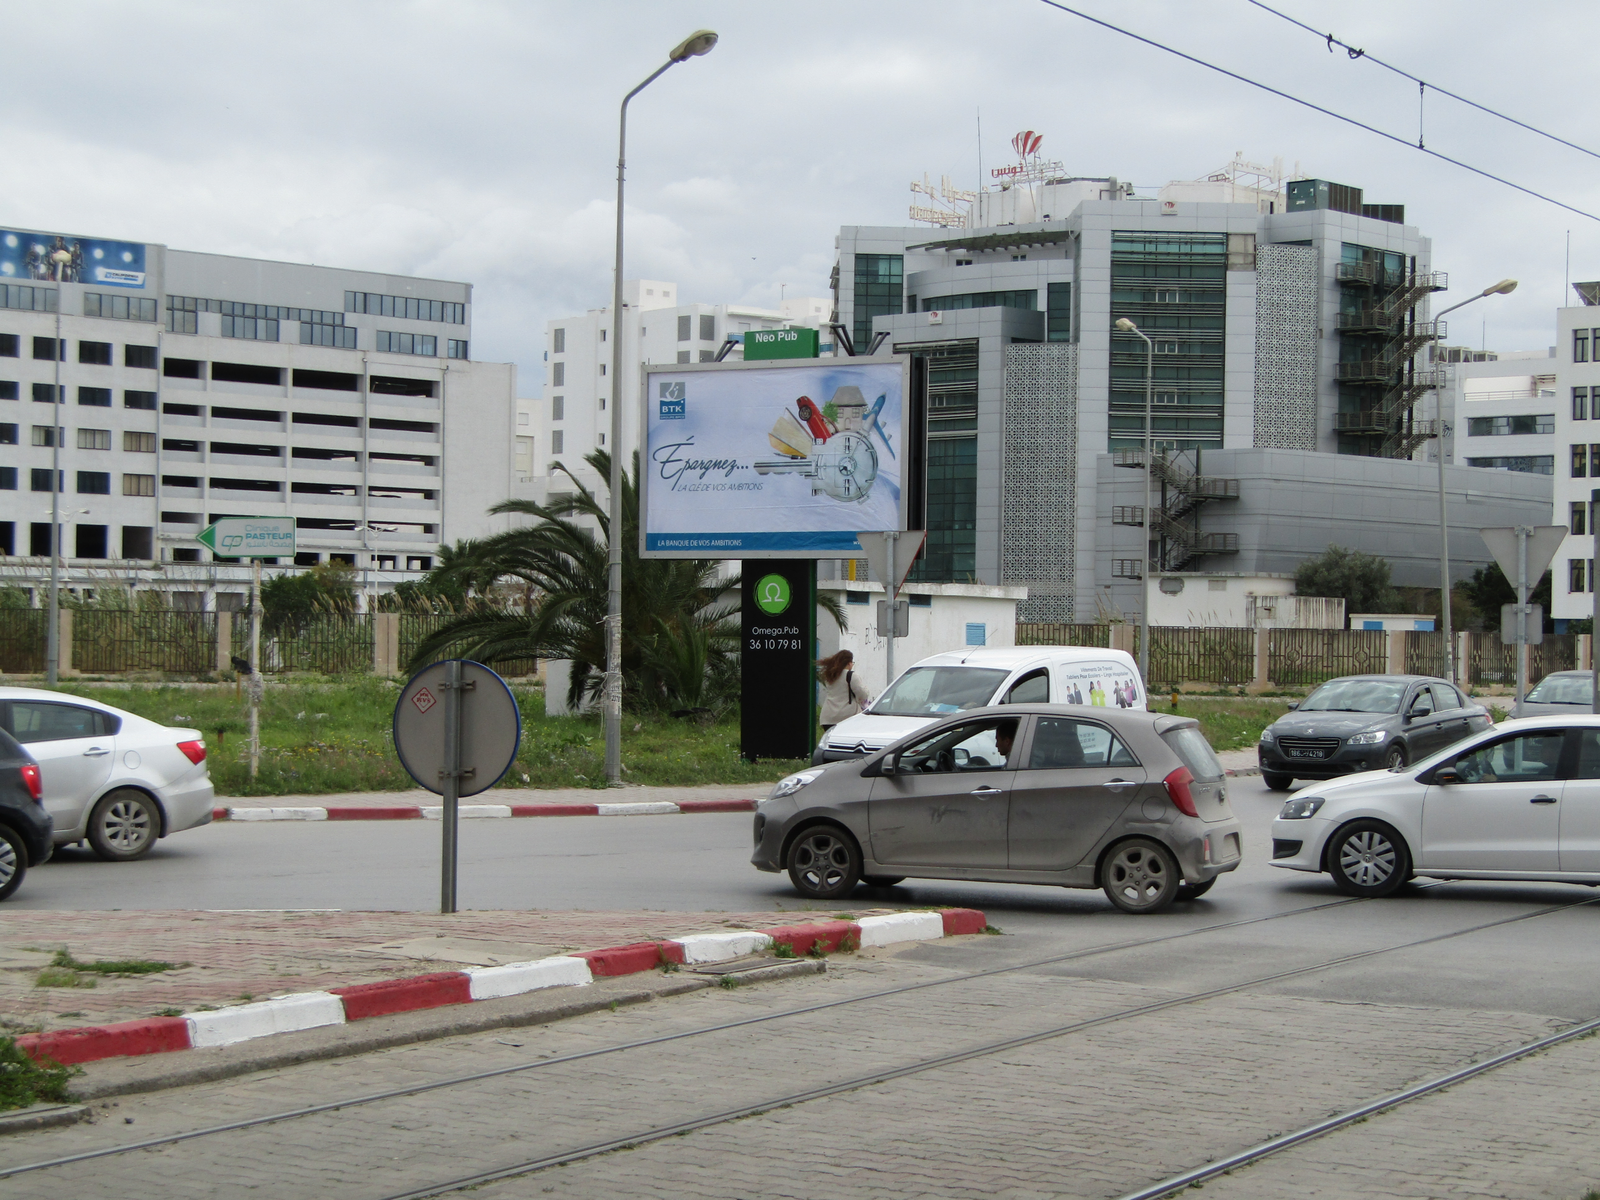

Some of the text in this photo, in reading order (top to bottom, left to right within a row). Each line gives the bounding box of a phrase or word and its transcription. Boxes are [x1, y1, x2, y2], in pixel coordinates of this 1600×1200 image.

[755, 331, 798, 343] Neo Pub
[662, 405, 682, 413] BTK
[677, 484, 687, 492] LA
[728, 482, 764, 491] AMBITIONS
[245, 524, 280, 533] Clinique
[245, 532, 293, 540] PASTEUR
[749, 639, 802, 650] 36 10 79 81
